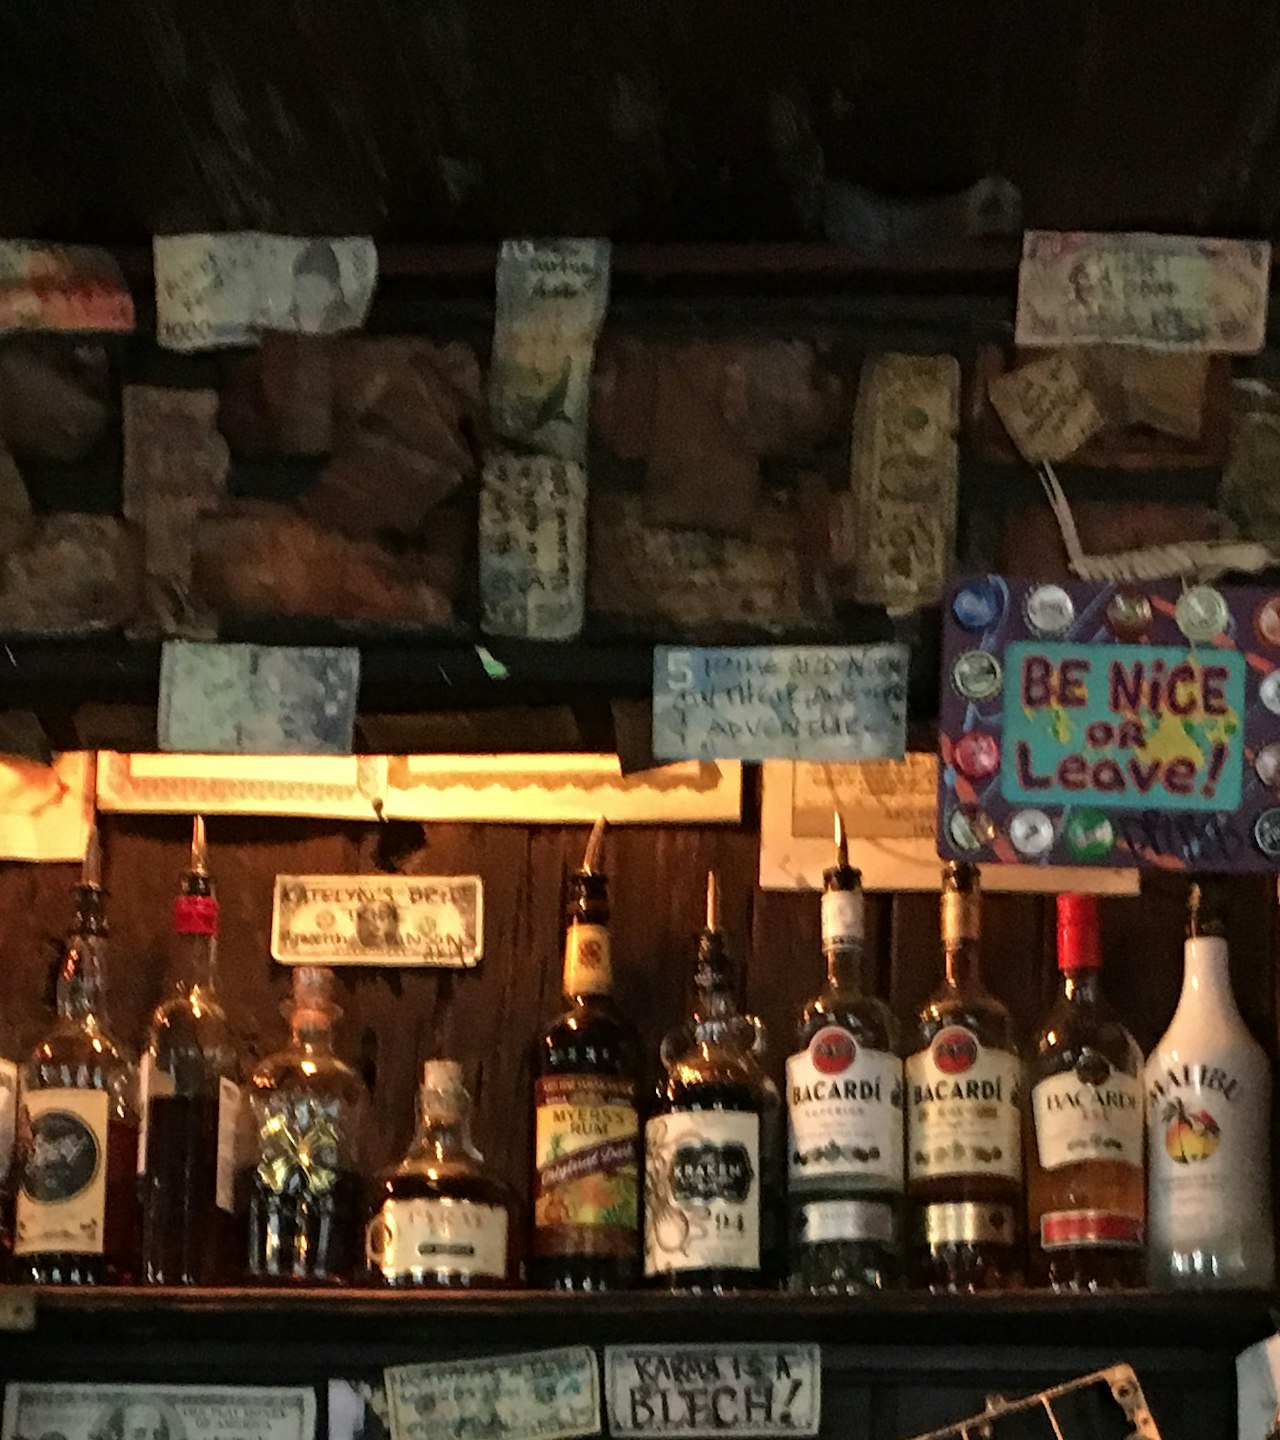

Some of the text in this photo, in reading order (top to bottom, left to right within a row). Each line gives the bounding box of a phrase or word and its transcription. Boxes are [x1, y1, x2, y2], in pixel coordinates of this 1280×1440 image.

[1021, 653, 1092, 708] BE
[1015, 738, 1230, 798] Leave!
[792, 1075, 882, 1106] BACARDÍ
[912, 1074, 1003, 1105] BACARDÍ
[569, 1121, 609, 1136] RUM
[775, 1354, 792, 1380] A
